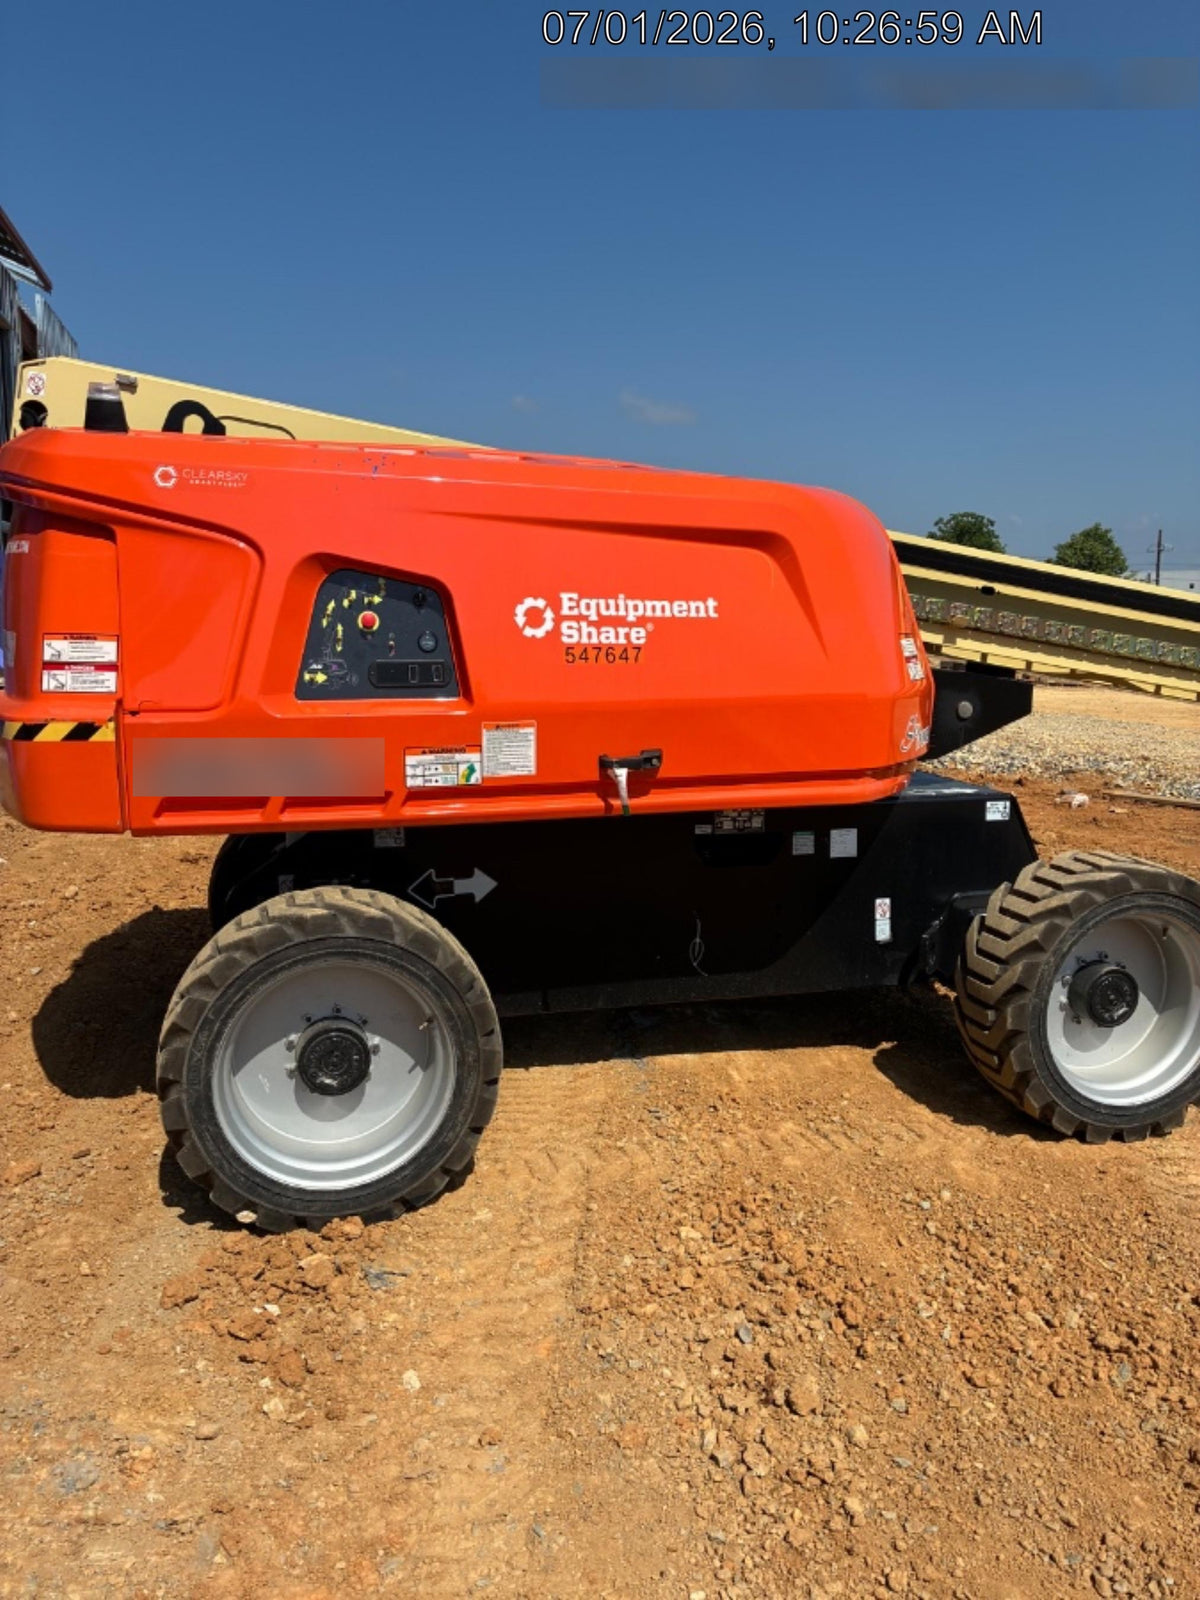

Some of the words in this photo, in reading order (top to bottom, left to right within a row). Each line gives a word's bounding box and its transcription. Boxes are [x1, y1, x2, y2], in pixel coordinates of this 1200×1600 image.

[182, 468, 248, 481] CLEARSKY
[559, 592, 719, 621] Equipment
[564, 646, 642, 664] 547647
